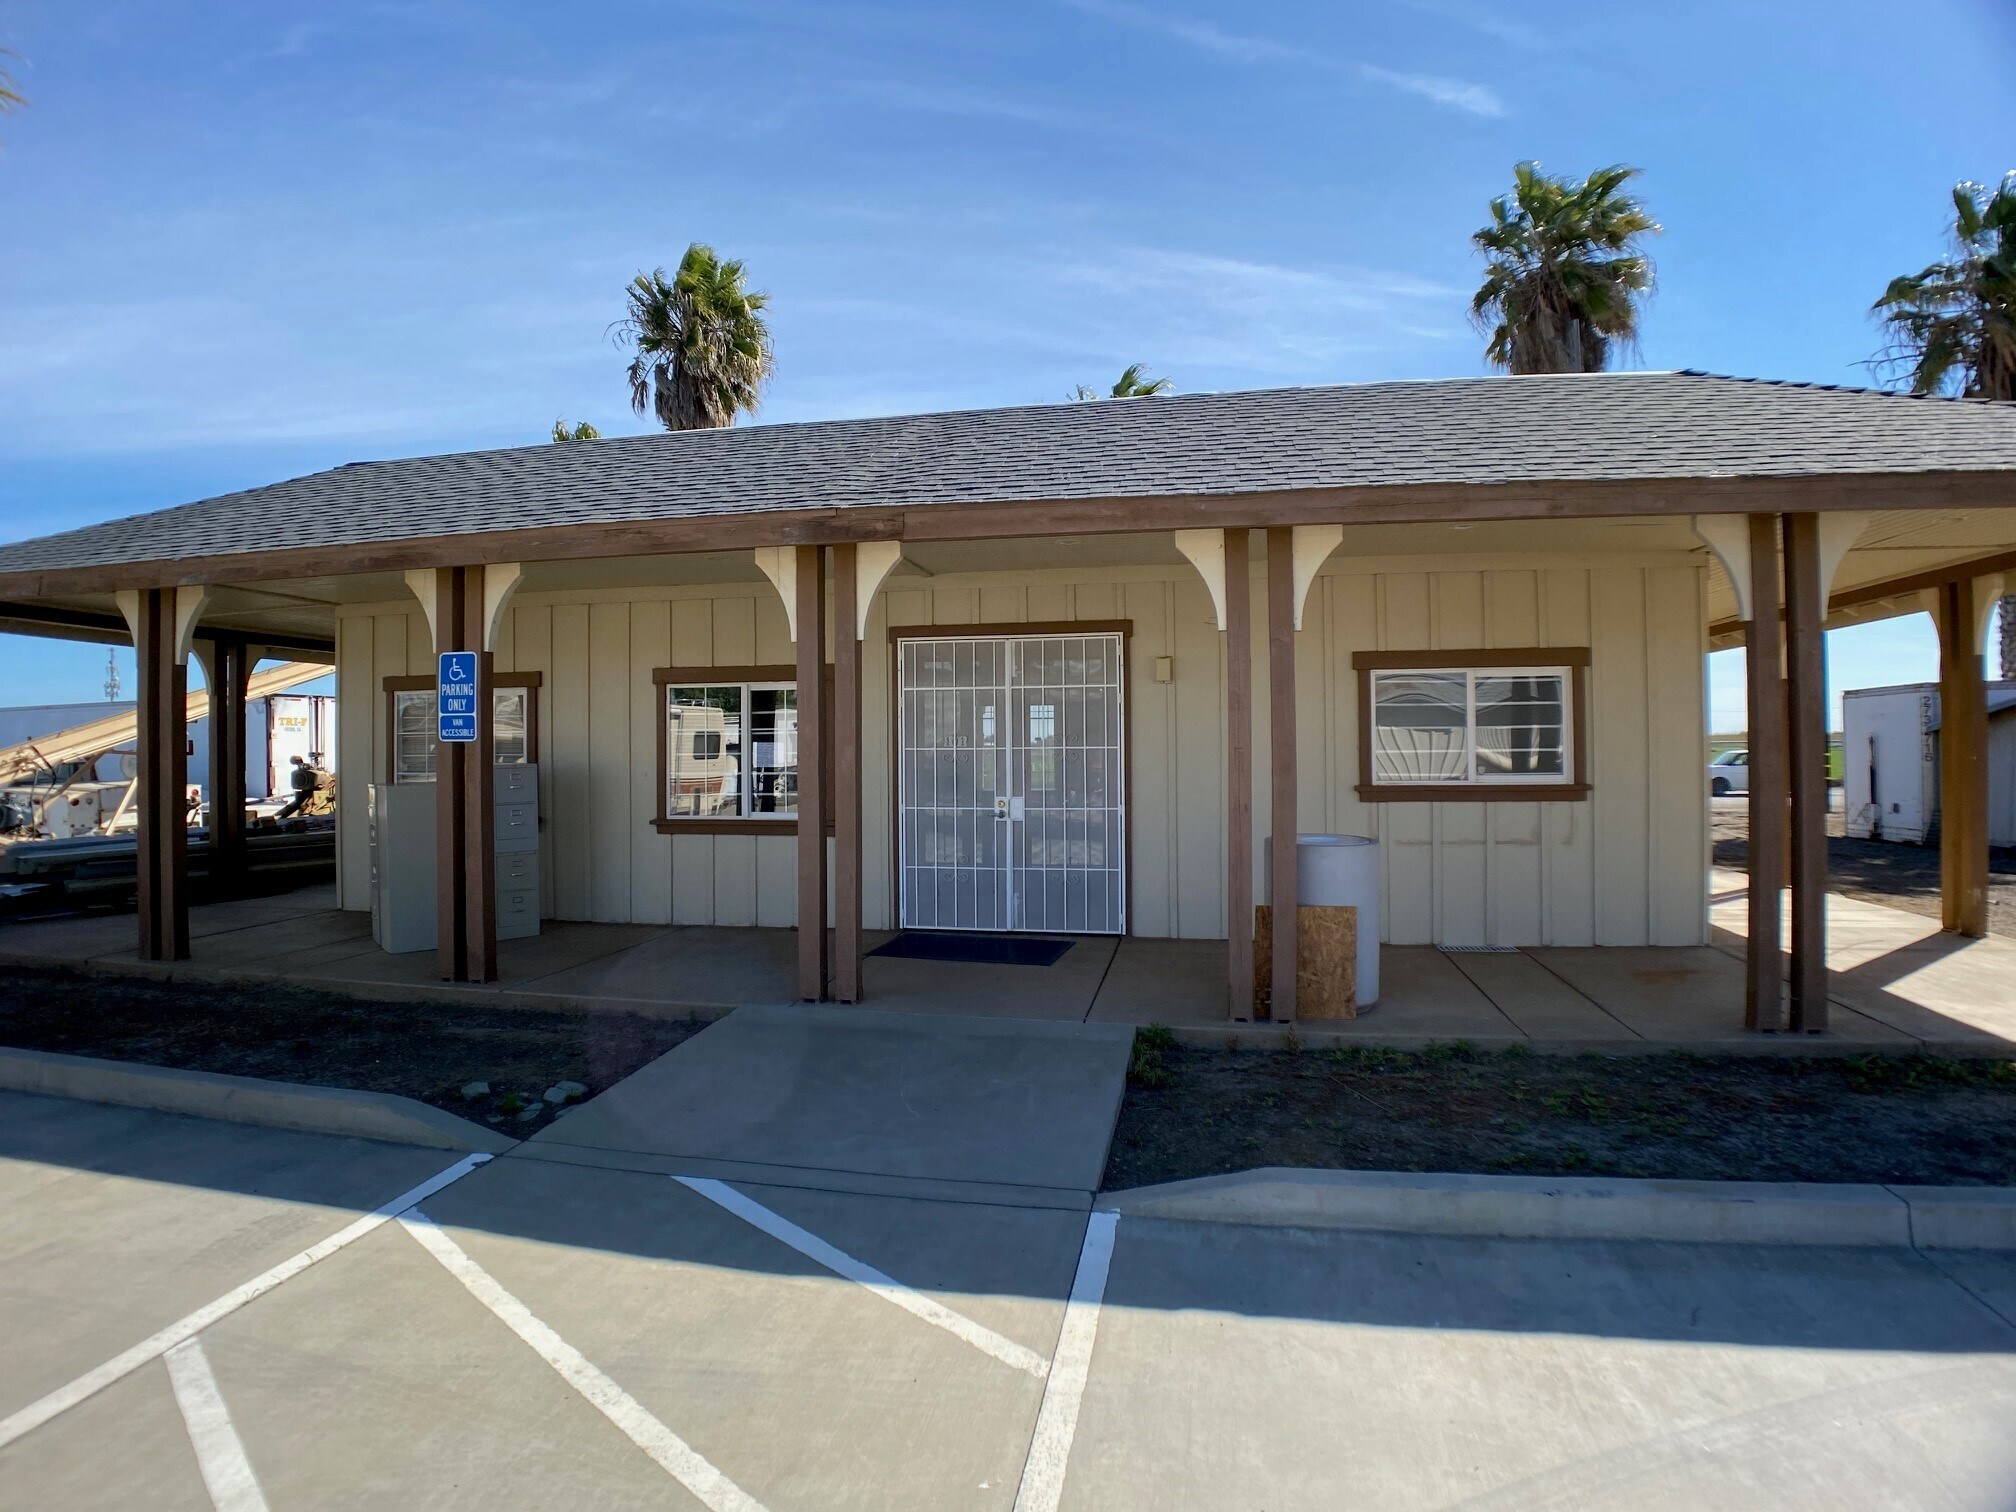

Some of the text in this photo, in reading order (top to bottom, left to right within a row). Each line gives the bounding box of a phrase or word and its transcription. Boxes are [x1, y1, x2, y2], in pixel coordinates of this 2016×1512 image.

[442, 683, 474, 696] PARKING
[448, 698, 467, 711] ONLY
[452, 718, 463, 726] VAN
[442, 728, 474, 737] ACCESSIBLE
